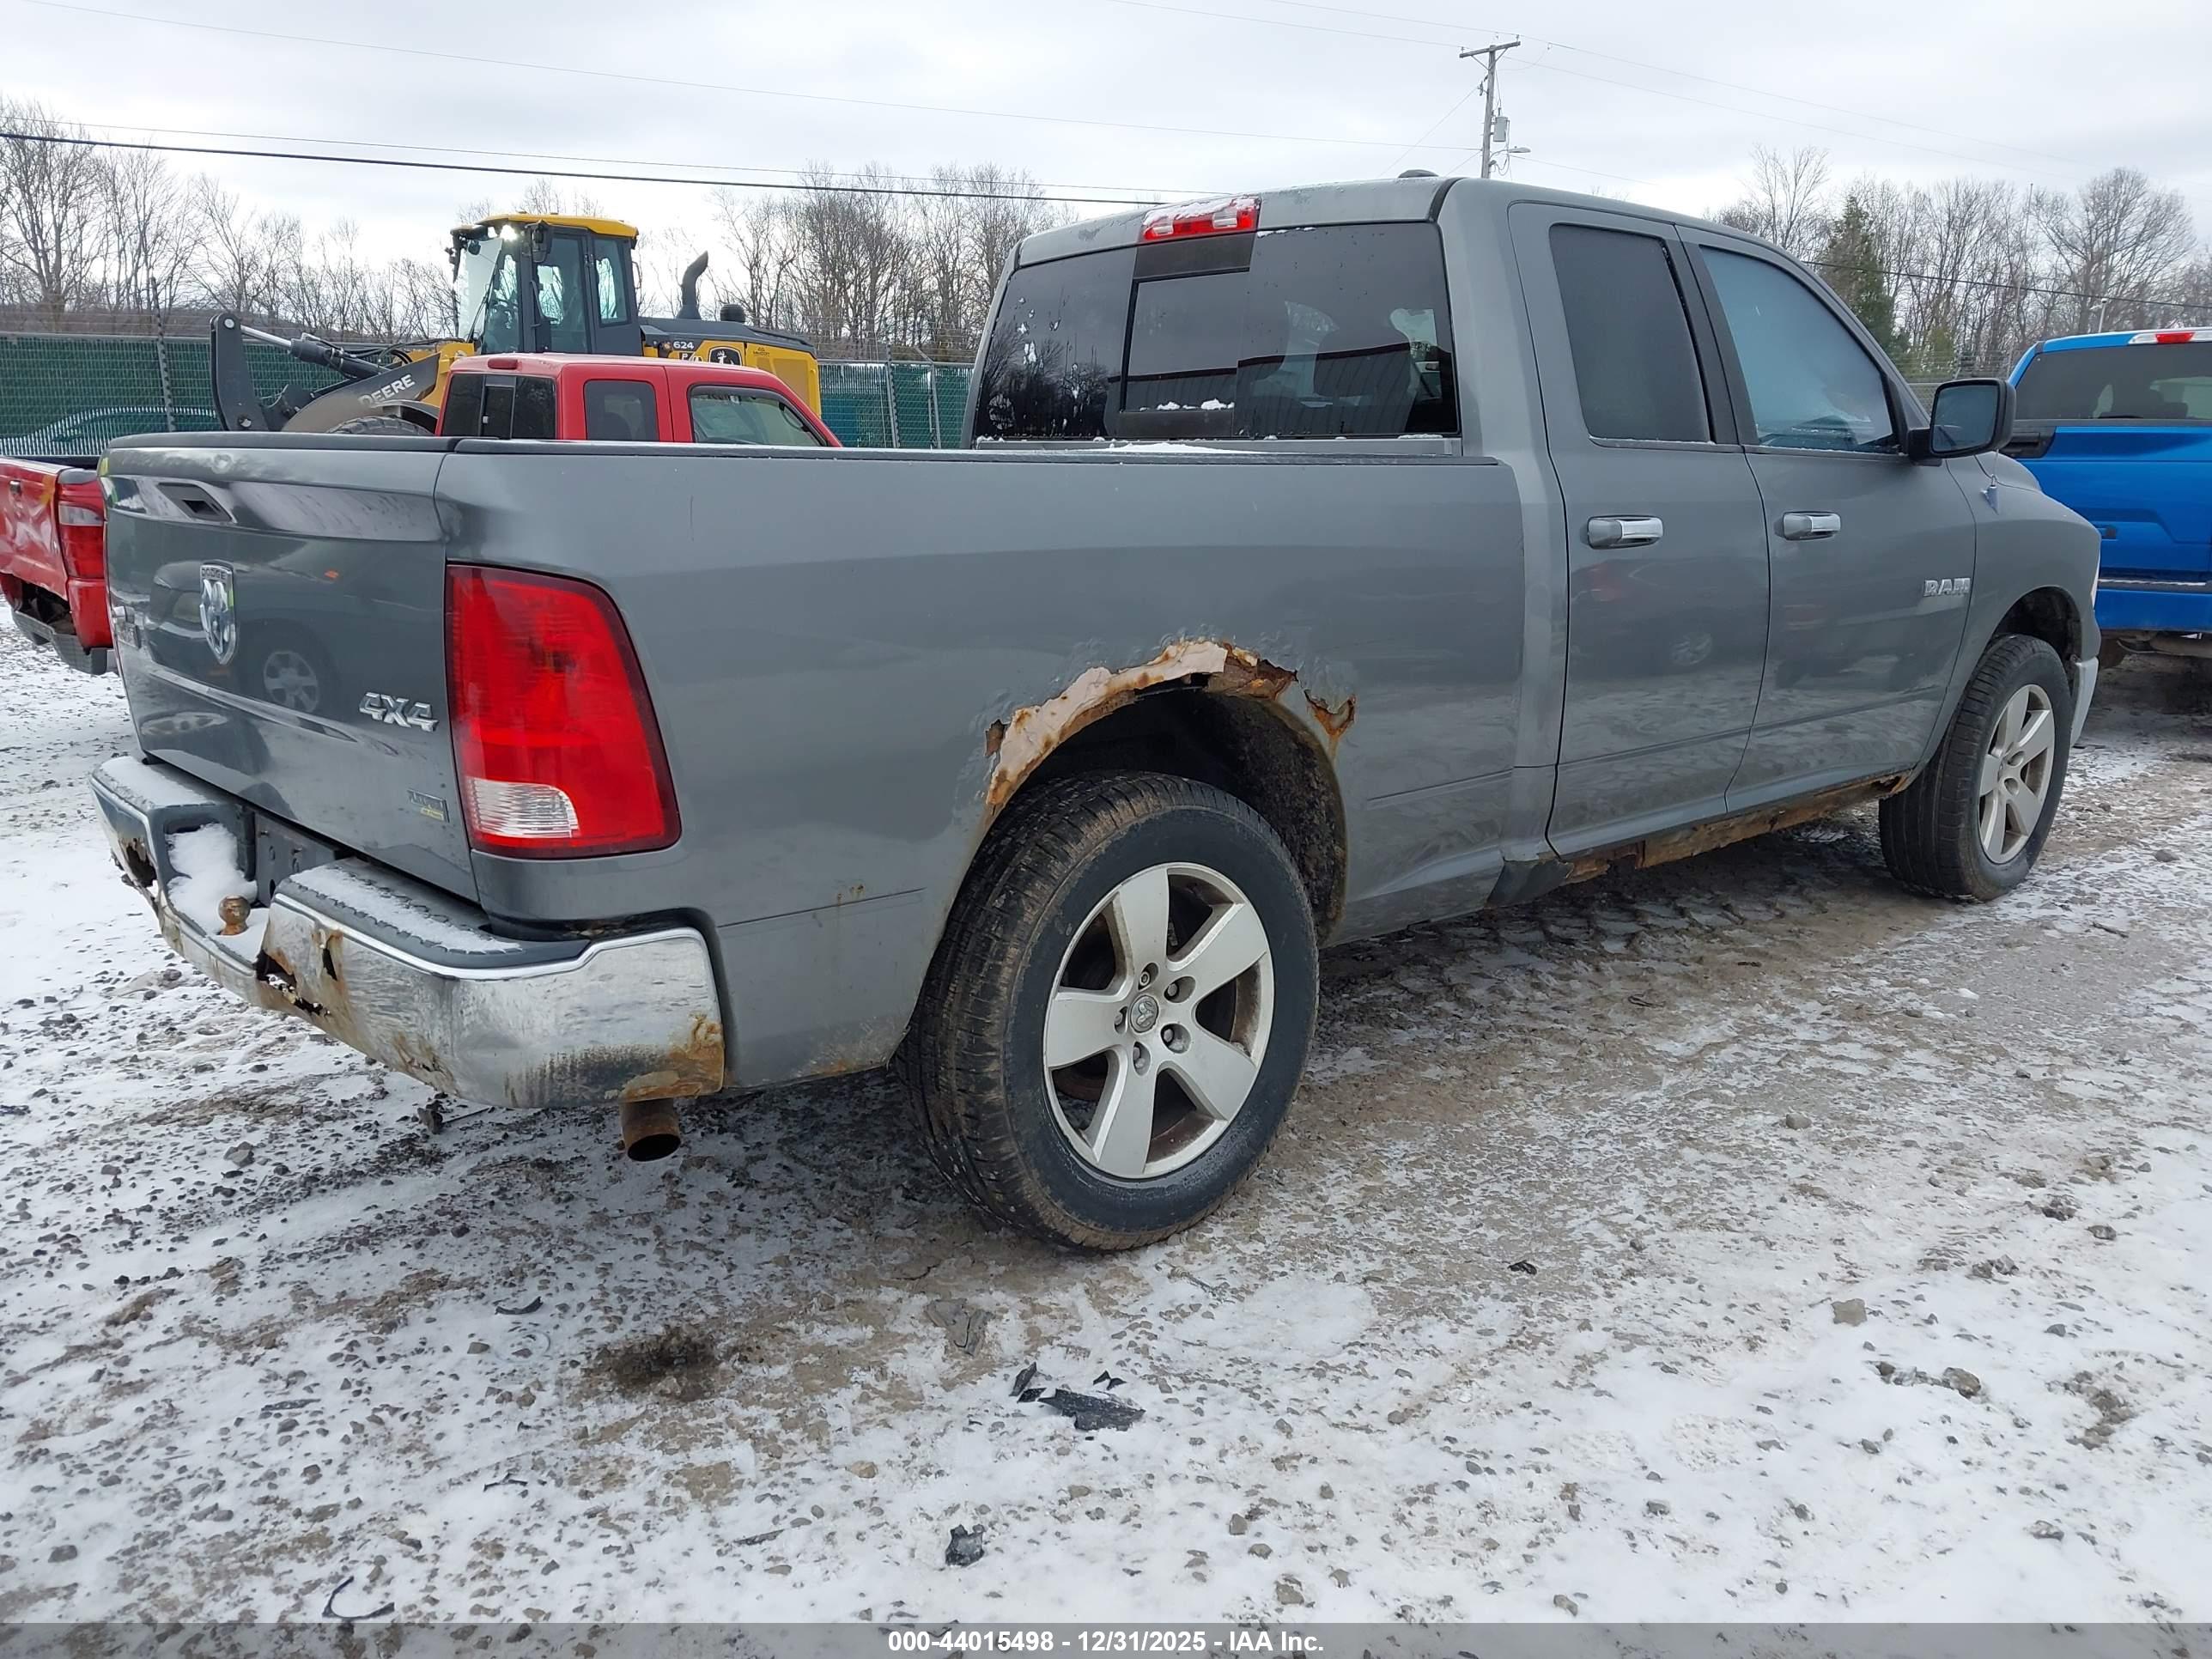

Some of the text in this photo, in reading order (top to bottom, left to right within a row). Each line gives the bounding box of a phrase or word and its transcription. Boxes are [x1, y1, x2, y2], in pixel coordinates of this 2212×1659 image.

[672, 341, 695, 350] 624
[358, 374, 416, 409] DEERE
[201, 567, 227, 580] DODGE
[1923, 577, 1971, 597] RAM
